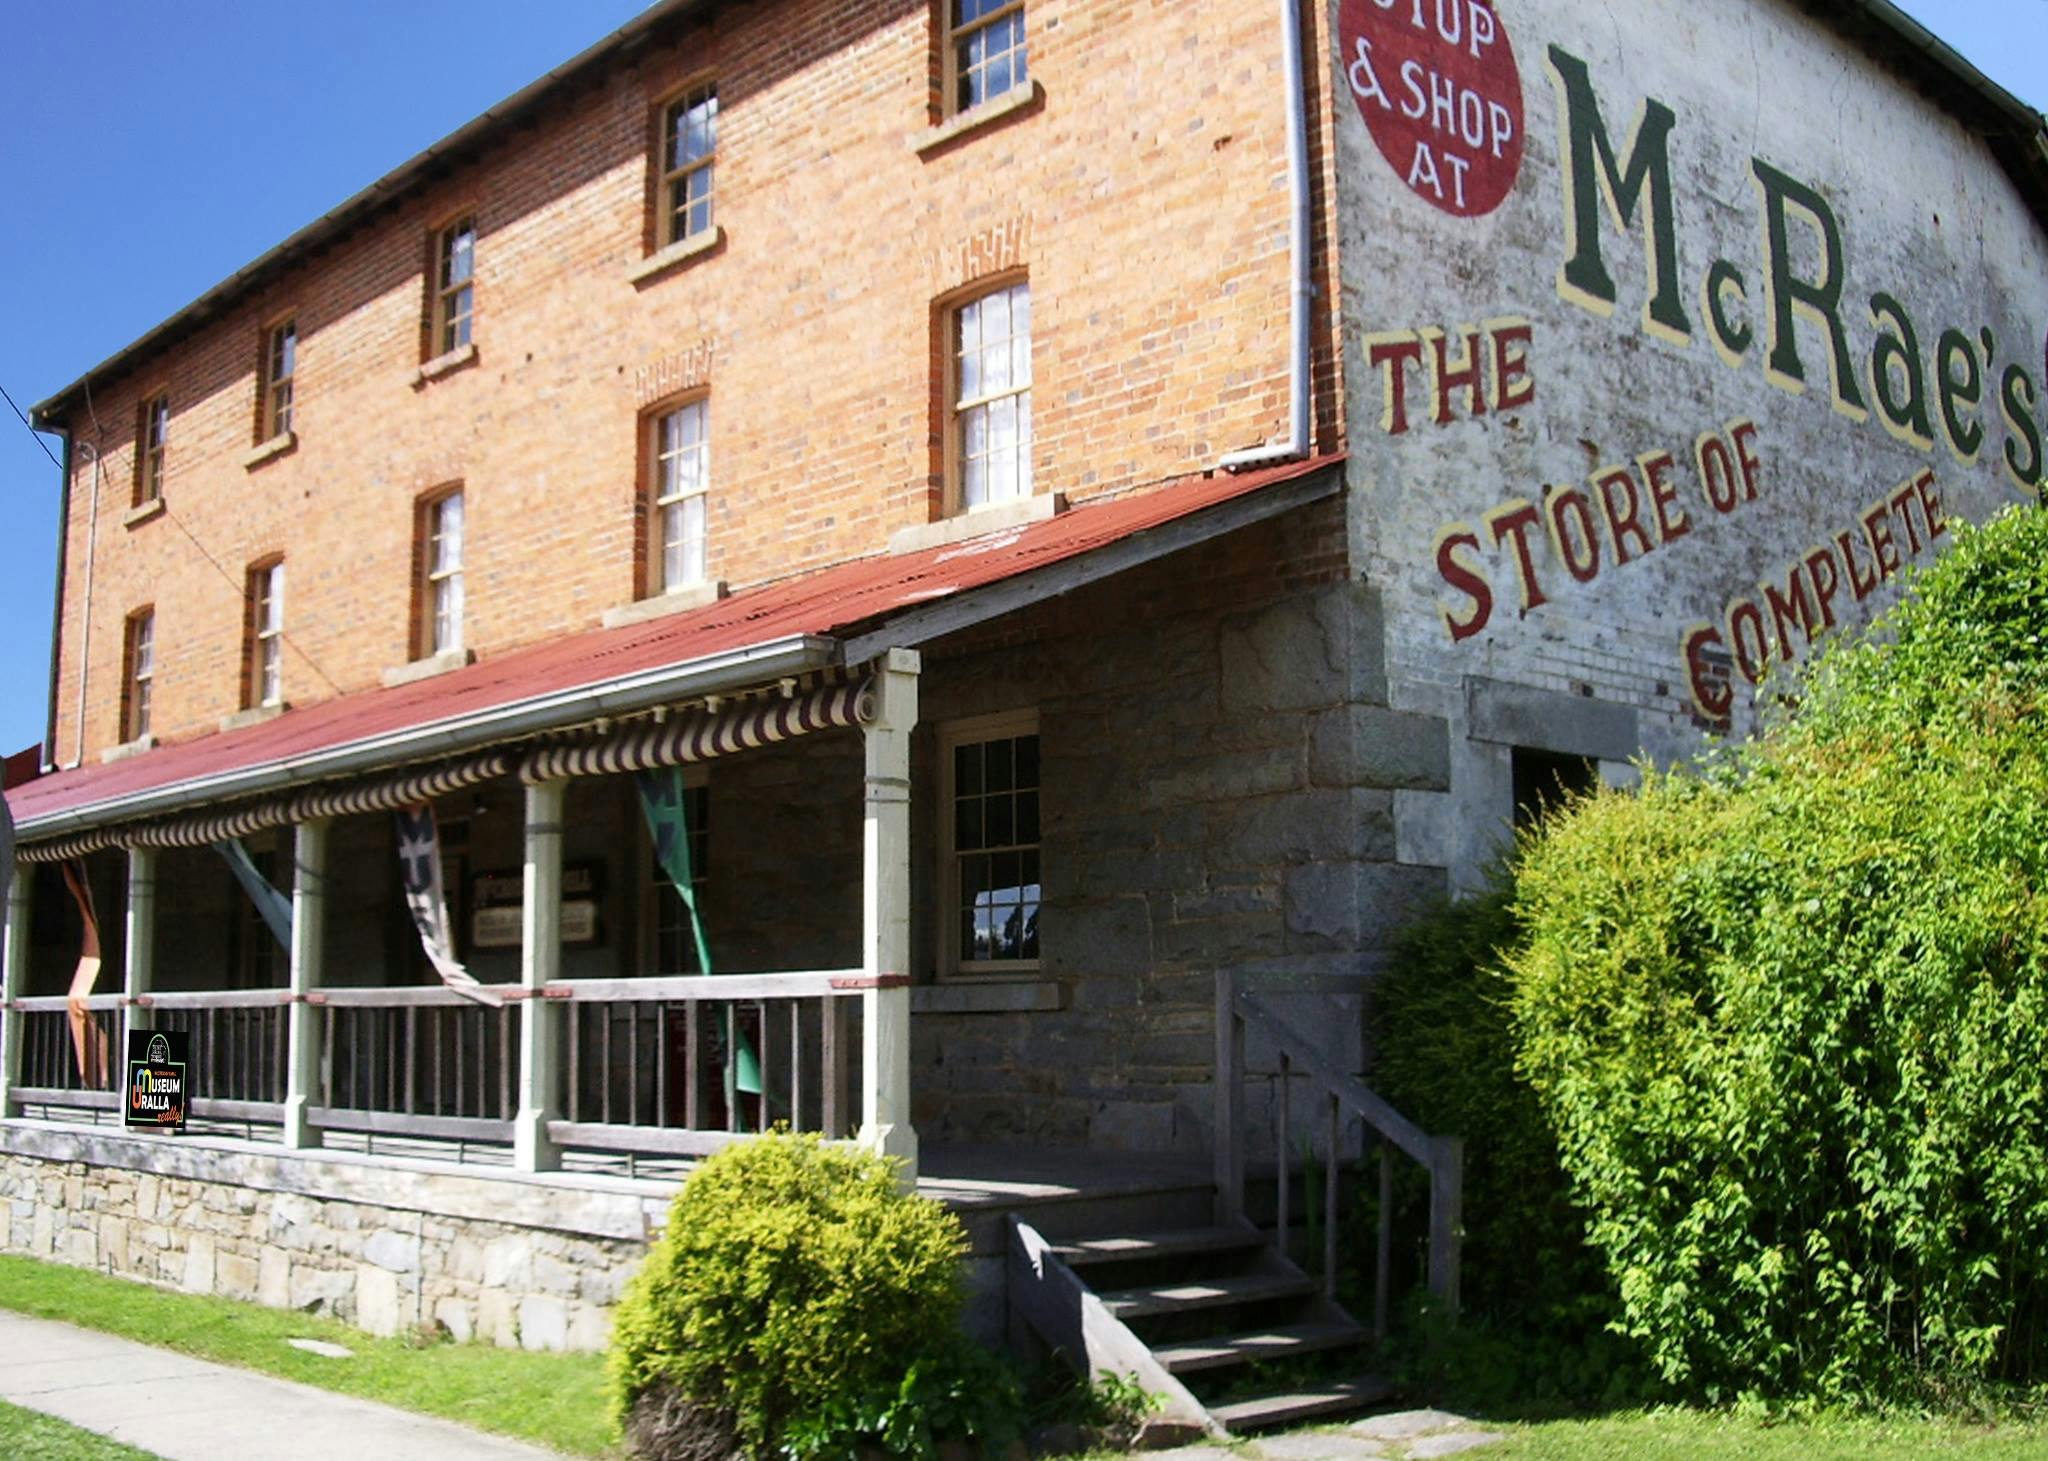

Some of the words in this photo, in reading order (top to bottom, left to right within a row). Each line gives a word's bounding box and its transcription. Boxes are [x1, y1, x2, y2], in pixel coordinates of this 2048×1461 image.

[1373, 0, 1495, 60] OP
[1350, 36, 1392, 111] &
[1400, 60, 1512, 158] SHOP
[1407, 141, 1470, 209] AT
[1546, 43, 2042, 496] McRae's
[1362, 316, 1534, 435] THE
[1431, 449, 1691, 643] STORE
[1697, 417, 1762, 513] OF
[1680, 466, 1948, 722] COMPLETE
[132, 1085, 170, 1110] URALLA
